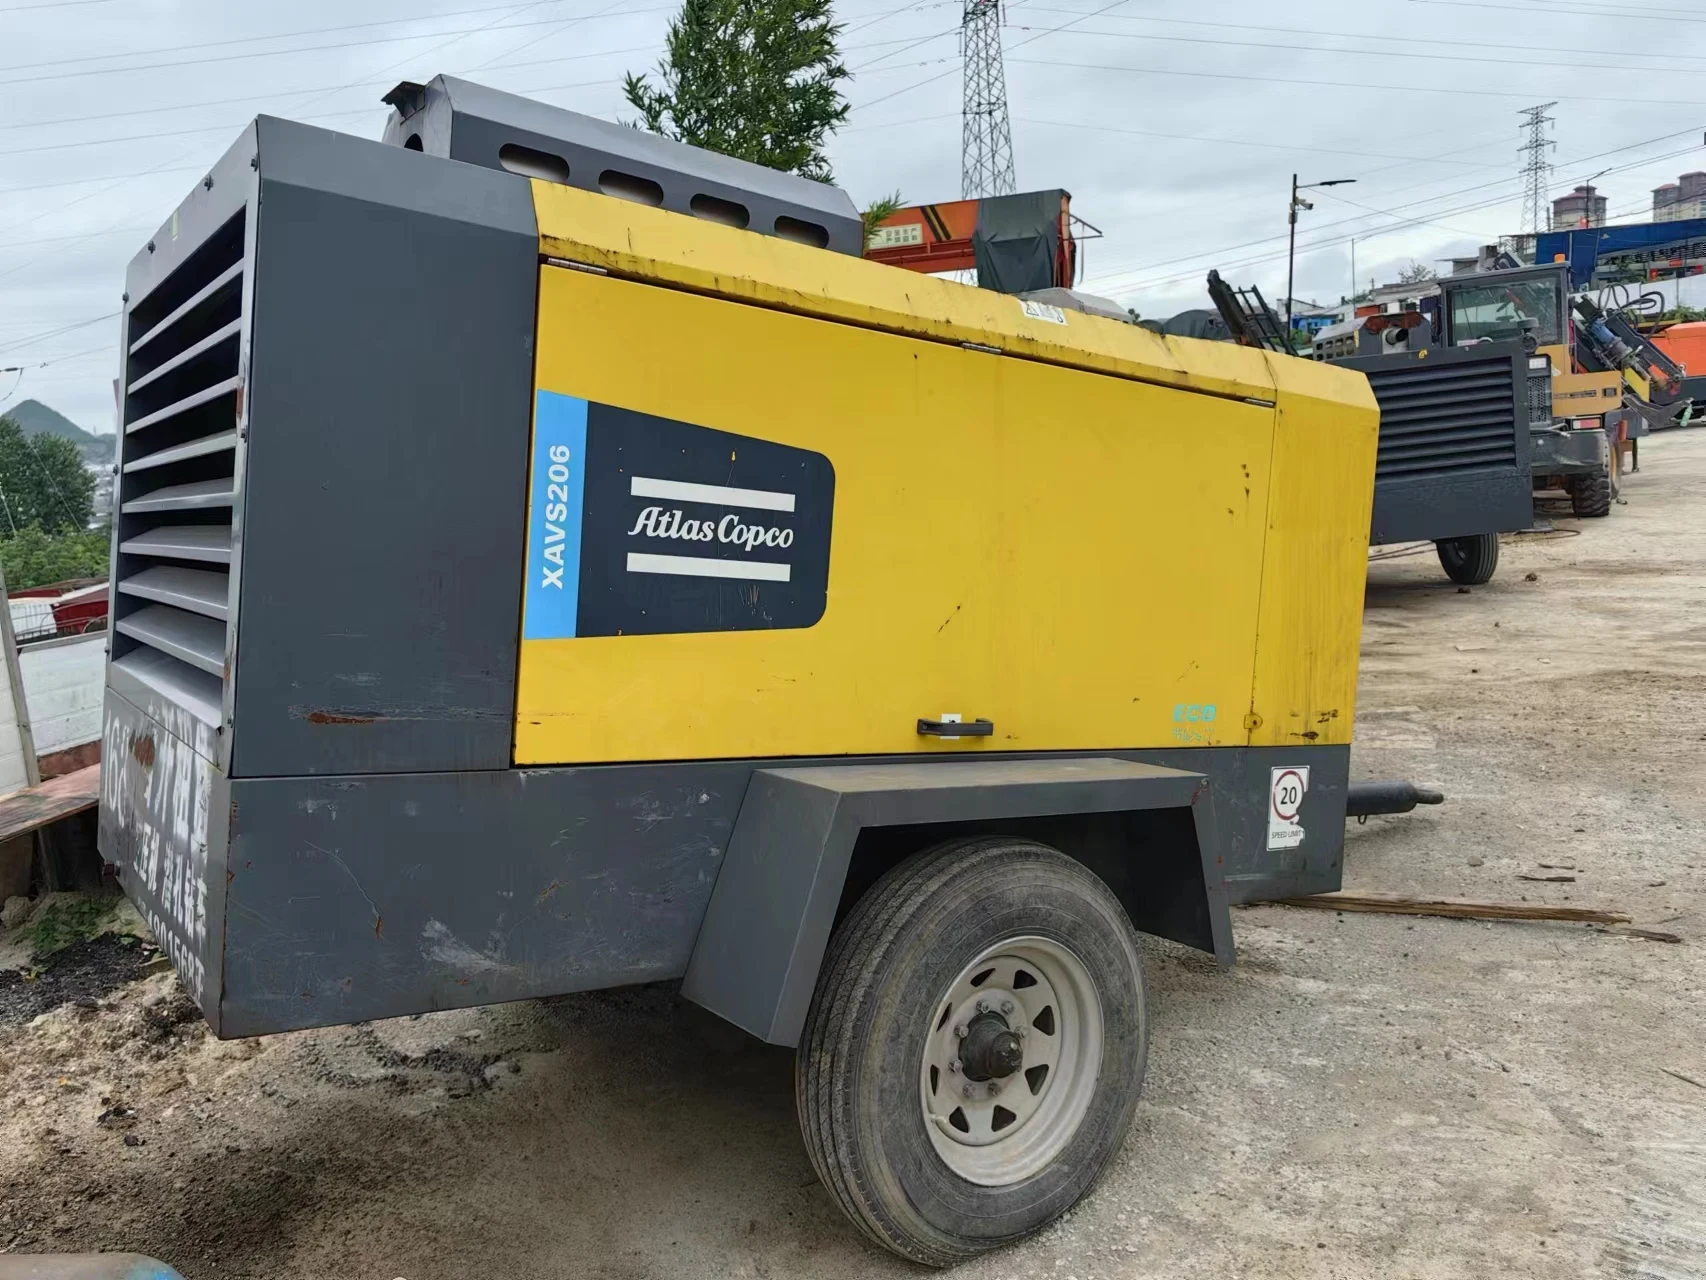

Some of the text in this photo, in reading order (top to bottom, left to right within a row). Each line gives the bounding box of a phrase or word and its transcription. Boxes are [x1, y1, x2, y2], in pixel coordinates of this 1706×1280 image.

[541, 445, 571, 590] XAVS206
[627, 506, 794, 551] Atlas Copco
[1173, 704, 1217, 723] ECO
[1280, 786, 1297, 805] 20
[1271, 829, 1301, 840] SPEED LIMIT
